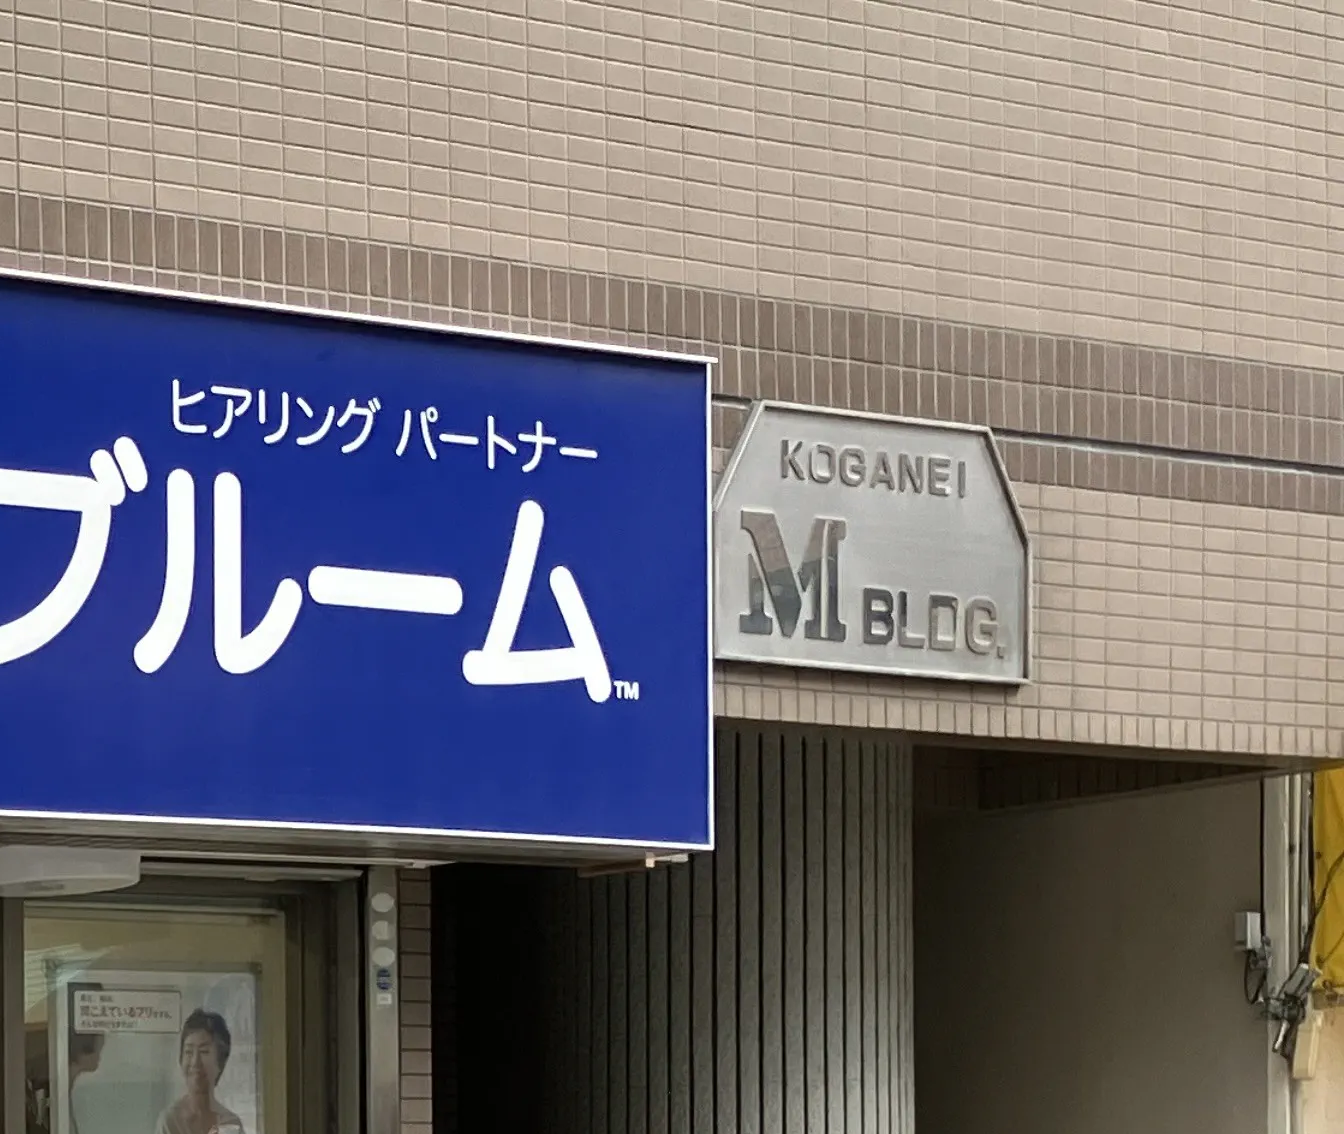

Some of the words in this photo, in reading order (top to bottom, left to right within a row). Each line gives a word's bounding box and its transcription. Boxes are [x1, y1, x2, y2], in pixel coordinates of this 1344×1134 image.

[170, 377, 383, 457] ヒアリング
[395, 403, 599, 474] パートナー
[780, 438, 967, 499] KOGANEI
[739, 506, 848, 643] M
[862, 586, 1006, 659] BLDG.
